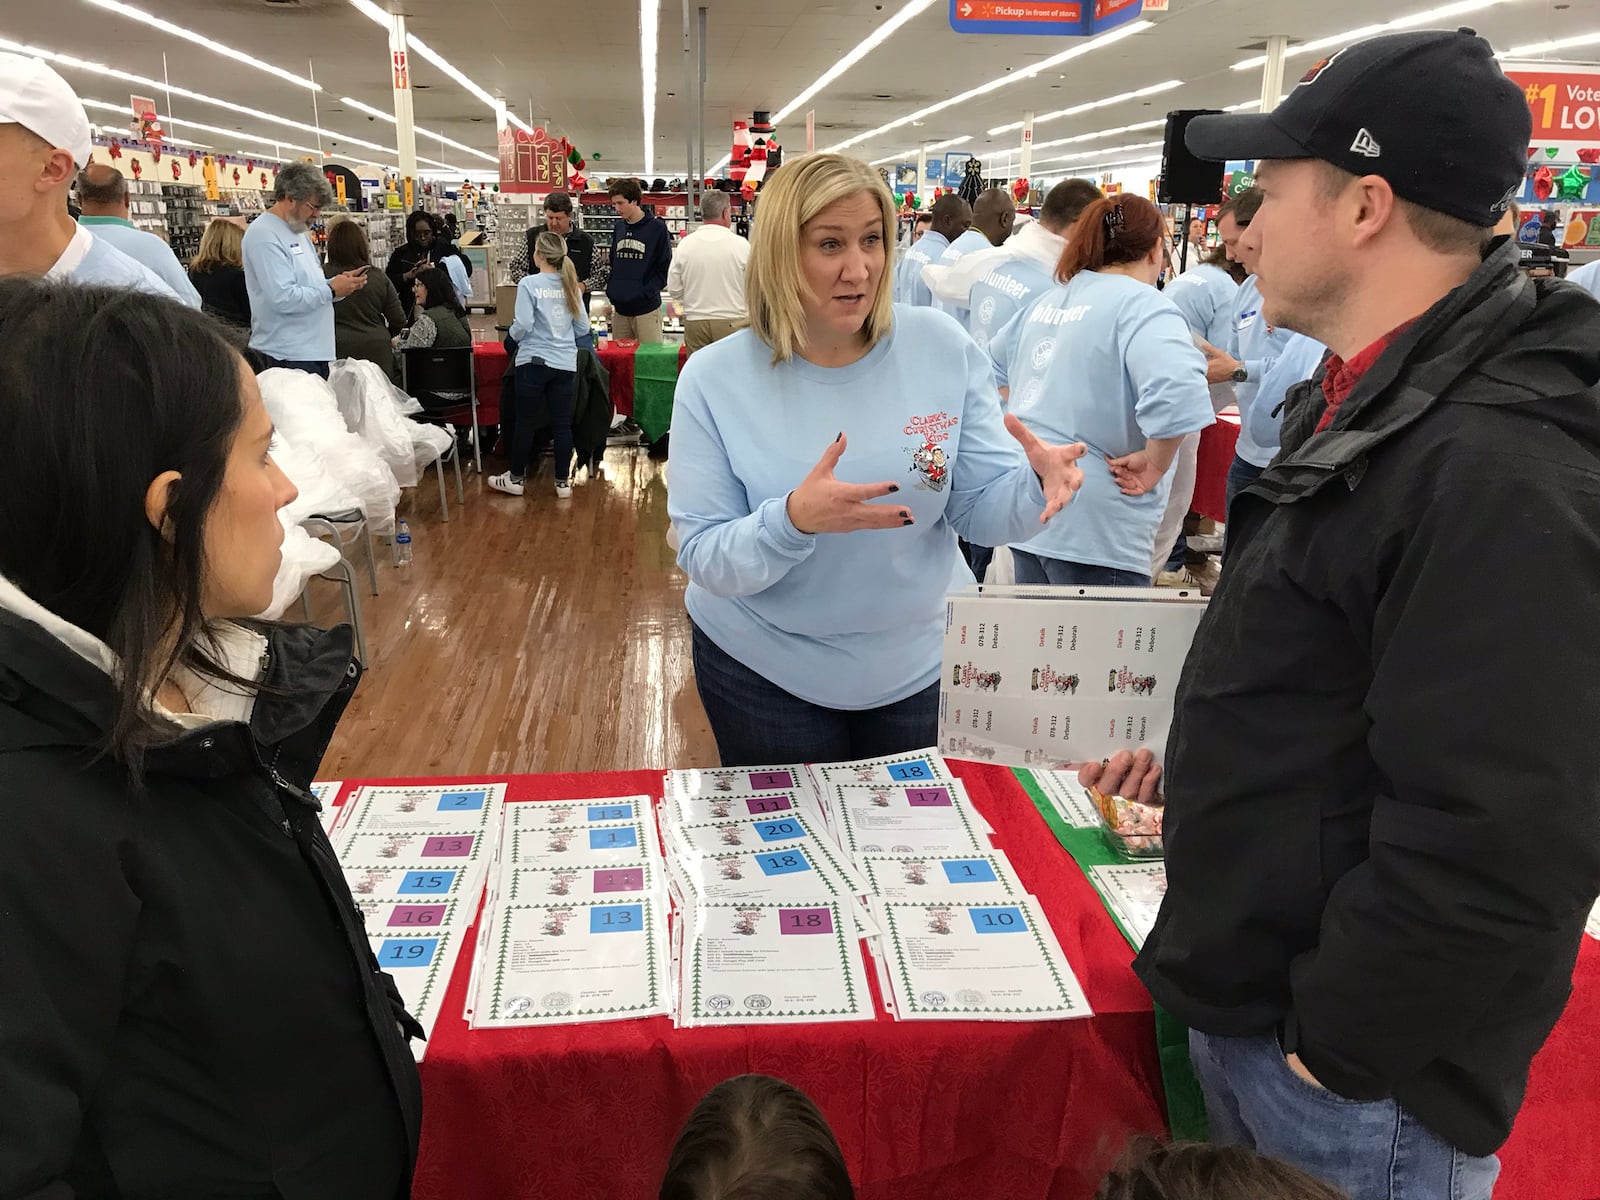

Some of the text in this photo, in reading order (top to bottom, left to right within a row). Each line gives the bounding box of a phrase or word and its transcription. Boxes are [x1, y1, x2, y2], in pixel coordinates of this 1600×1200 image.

[994, 6, 1025, 17] Pickup
[1033, 9, 1050, 17] front
[1525, 83, 1557, 129] #1
[1560, 105, 1600, 130] LO
[1241, 176, 1256, 188] Gif
[980, 268, 1031, 299] lunteer
[535, 287, 566, 299] Volunt
[978, 622, 986, 648] 078-312
[991, 623, 999, 649] Deborah
[1070, 625, 1078, 650] Deborah
[1135, 626, 1143, 650] 078-312
[1148, 627, 1156, 652] Deborah
[985, 711, 993, 731] Deborah
[1063, 716, 1071, 740] Deborah
[1139, 717, 1147, 741] Deborah
[898, 766, 924, 779] 18
[766, 775, 777, 785] 1
[455, 796, 468, 807] 2
[915, 792, 940, 802] 17
[756, 801, 784, 812] 11
[598, 809, 624, 820] 13
[764, 823, 794, 836] 20
[607, 833, 618, 843] 1
[436, 840, 464, 851] 13
[767, 855, 798, 869] 18
[962, 865, 978, 876] 1
[411, 876, 444, 888] 15
[403, 911, 434, 924] 16
[601, 911, 633, 925] 13
[790, 913, 823, 928] 18
[981, 912, 1014, 926] 10
[388, 945, 426, 959] 19
